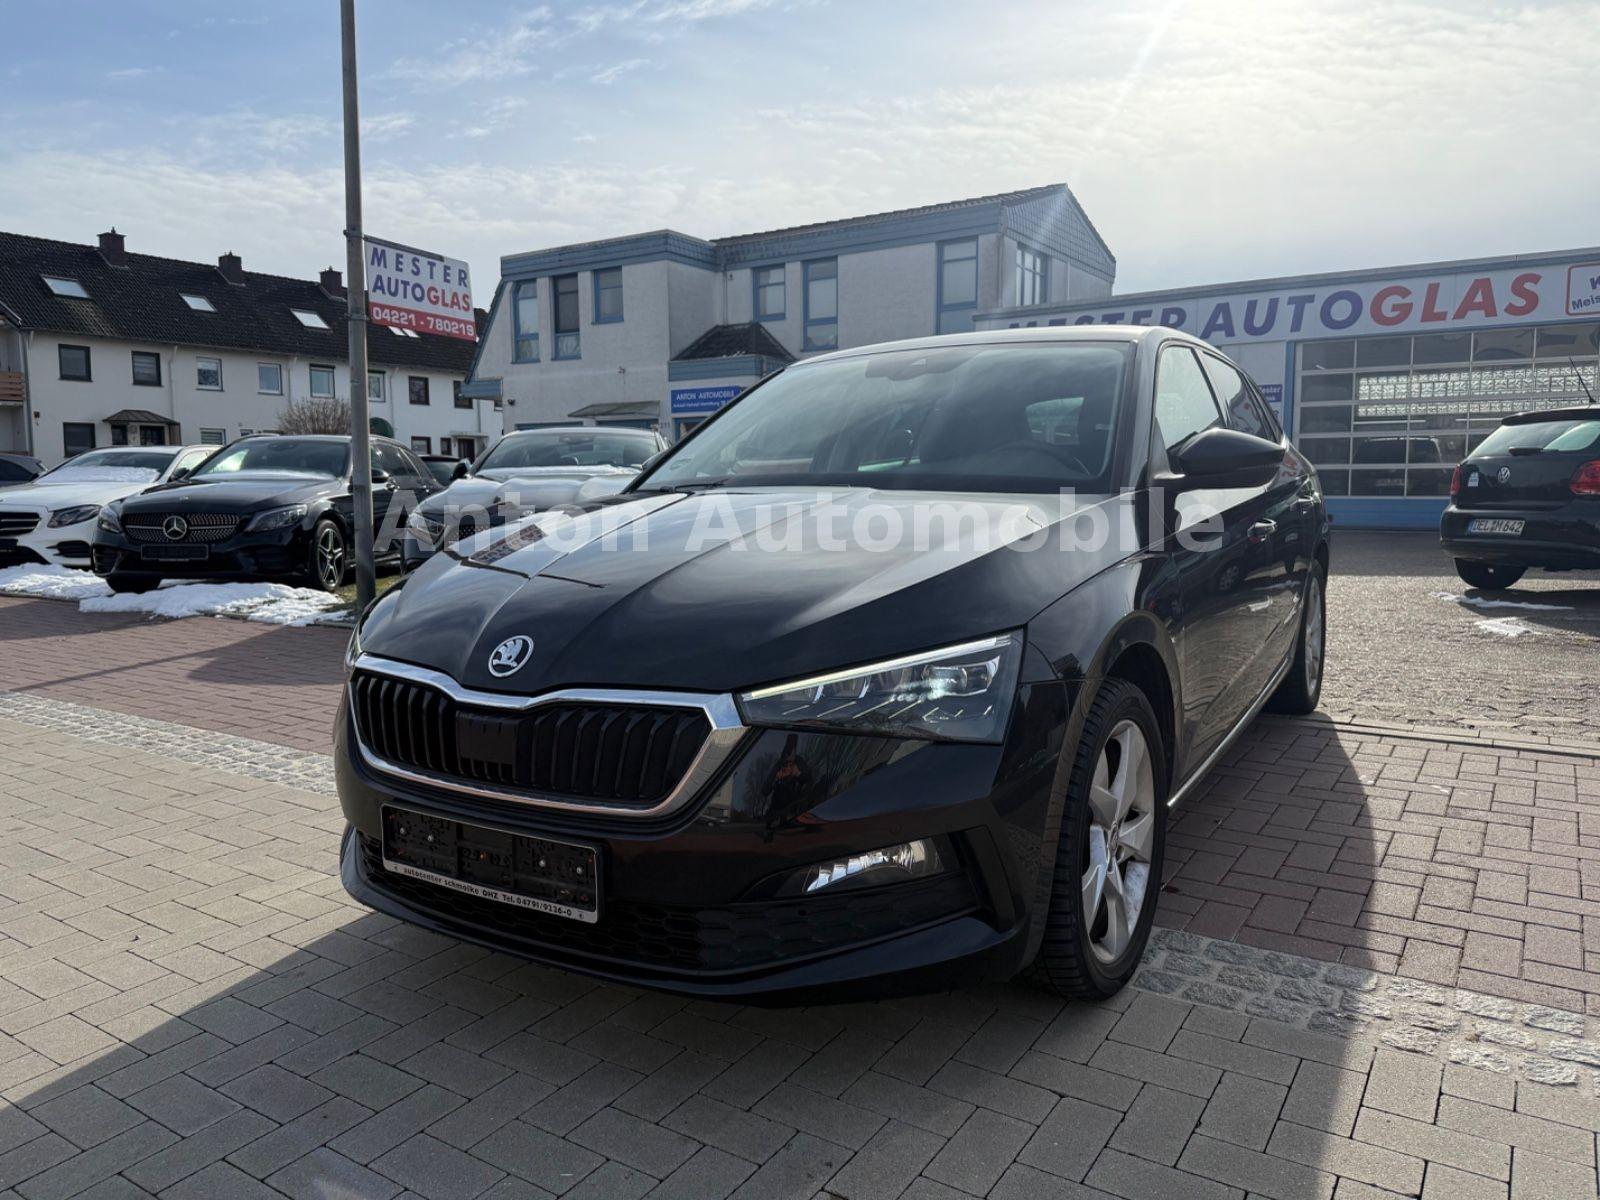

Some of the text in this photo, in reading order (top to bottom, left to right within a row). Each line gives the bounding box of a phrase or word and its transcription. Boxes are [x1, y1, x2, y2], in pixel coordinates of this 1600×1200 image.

[370, 247, 468, 288] MESTER
[372, 274, 471, 312] AUTOGLAS
[1199, 273, 1542, 339] AUTOGLAS
[426, 316, 475, 336] 780219
[676, 392, 697, 401] ANTON
